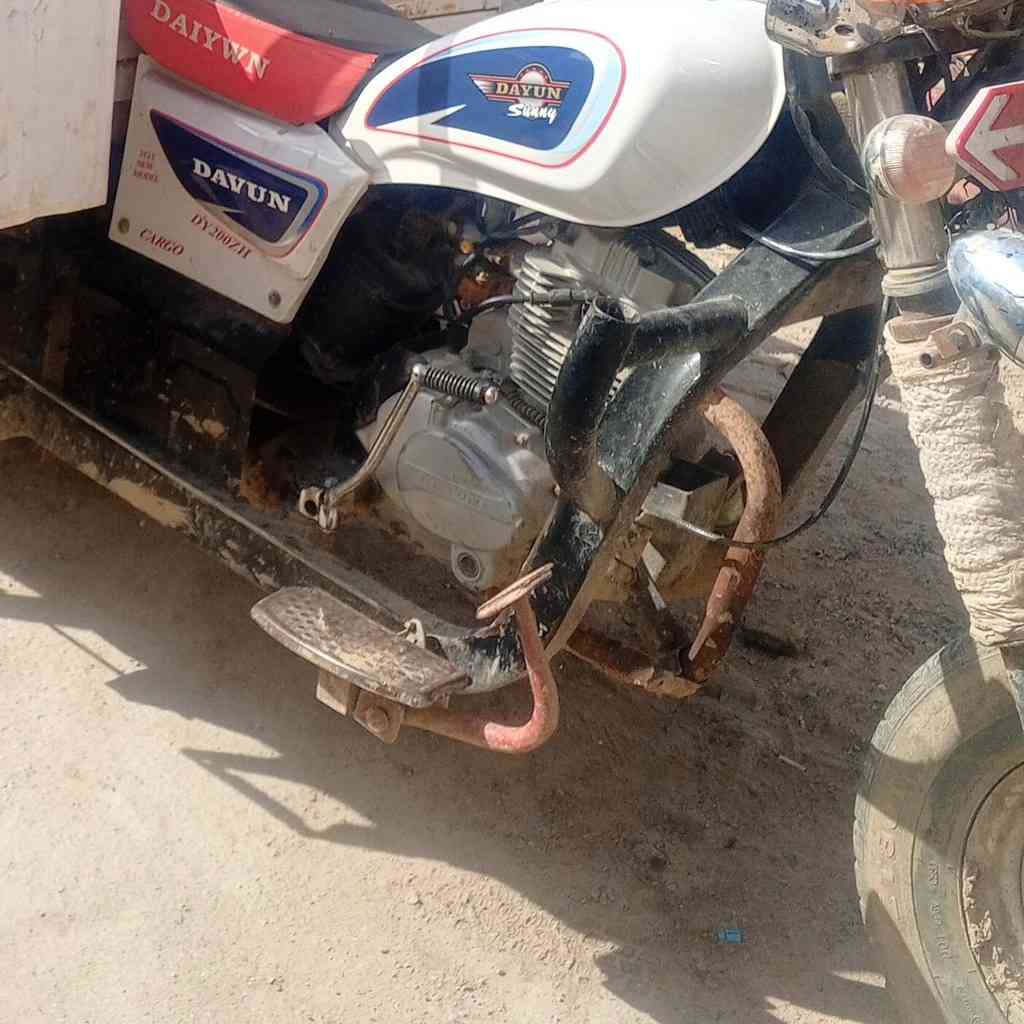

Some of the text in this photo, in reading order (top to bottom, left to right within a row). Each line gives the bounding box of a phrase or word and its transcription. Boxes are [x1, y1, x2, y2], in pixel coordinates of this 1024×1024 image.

[495, 82, 562, 100] DAYUN
[507, 103, 557, 125] Sunny
[193, 158, 292, 213] DAYUN
[139, 228, 185, 256] CARGO
